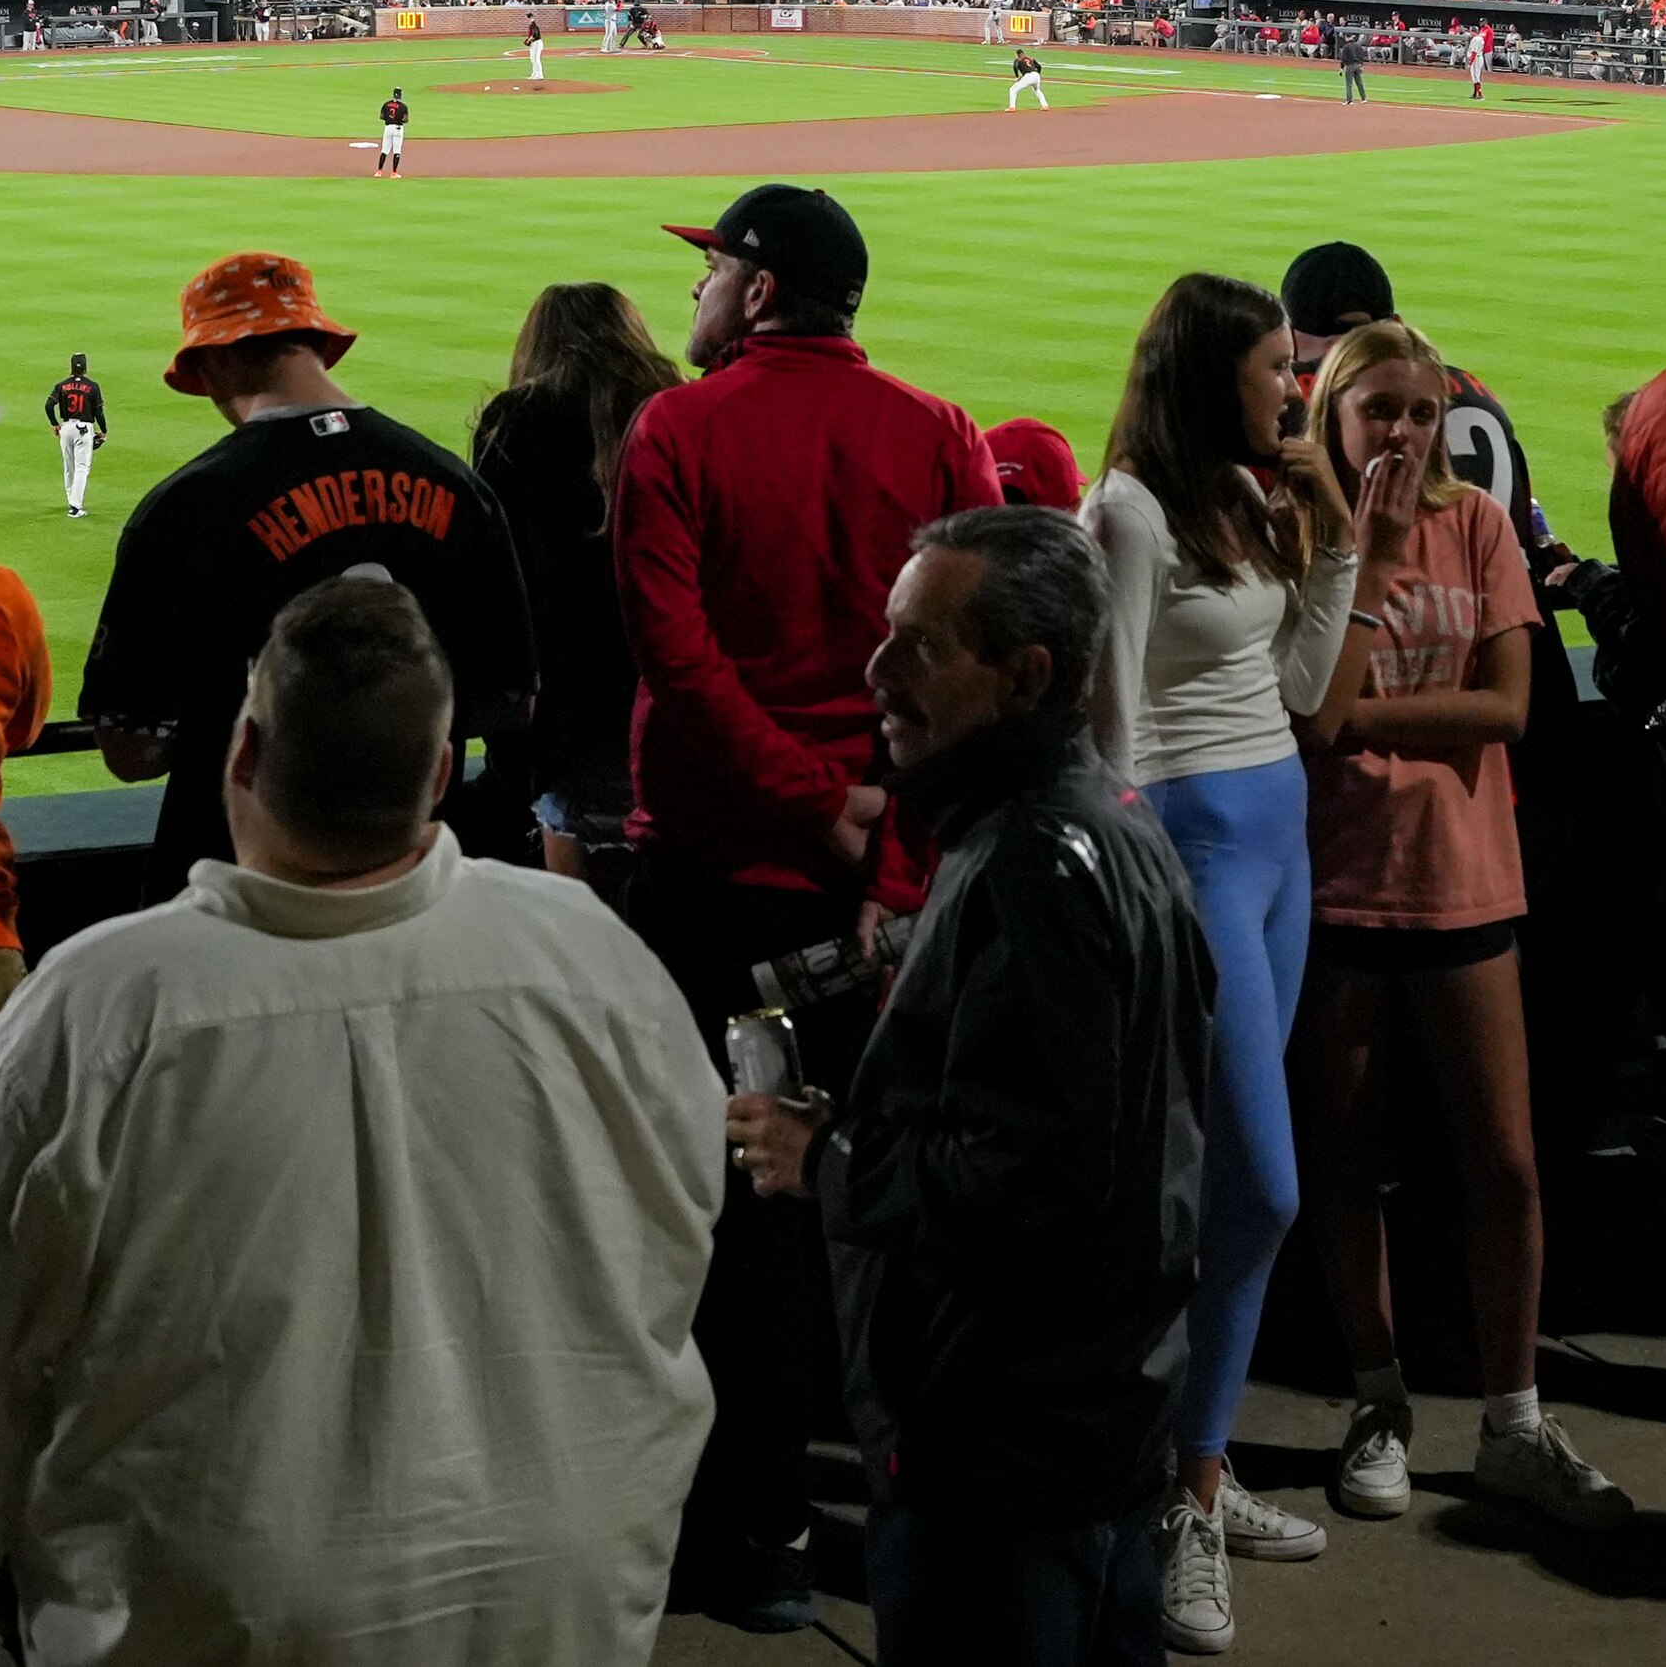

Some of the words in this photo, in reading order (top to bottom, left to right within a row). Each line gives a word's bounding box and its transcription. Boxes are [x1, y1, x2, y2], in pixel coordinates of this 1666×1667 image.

[397, 11, 425, 30] 007
[1010, 15, 1033, 32] 007
[67, 393, 85, 413] 31
[247, 468, 457, 564] HENDERSON
